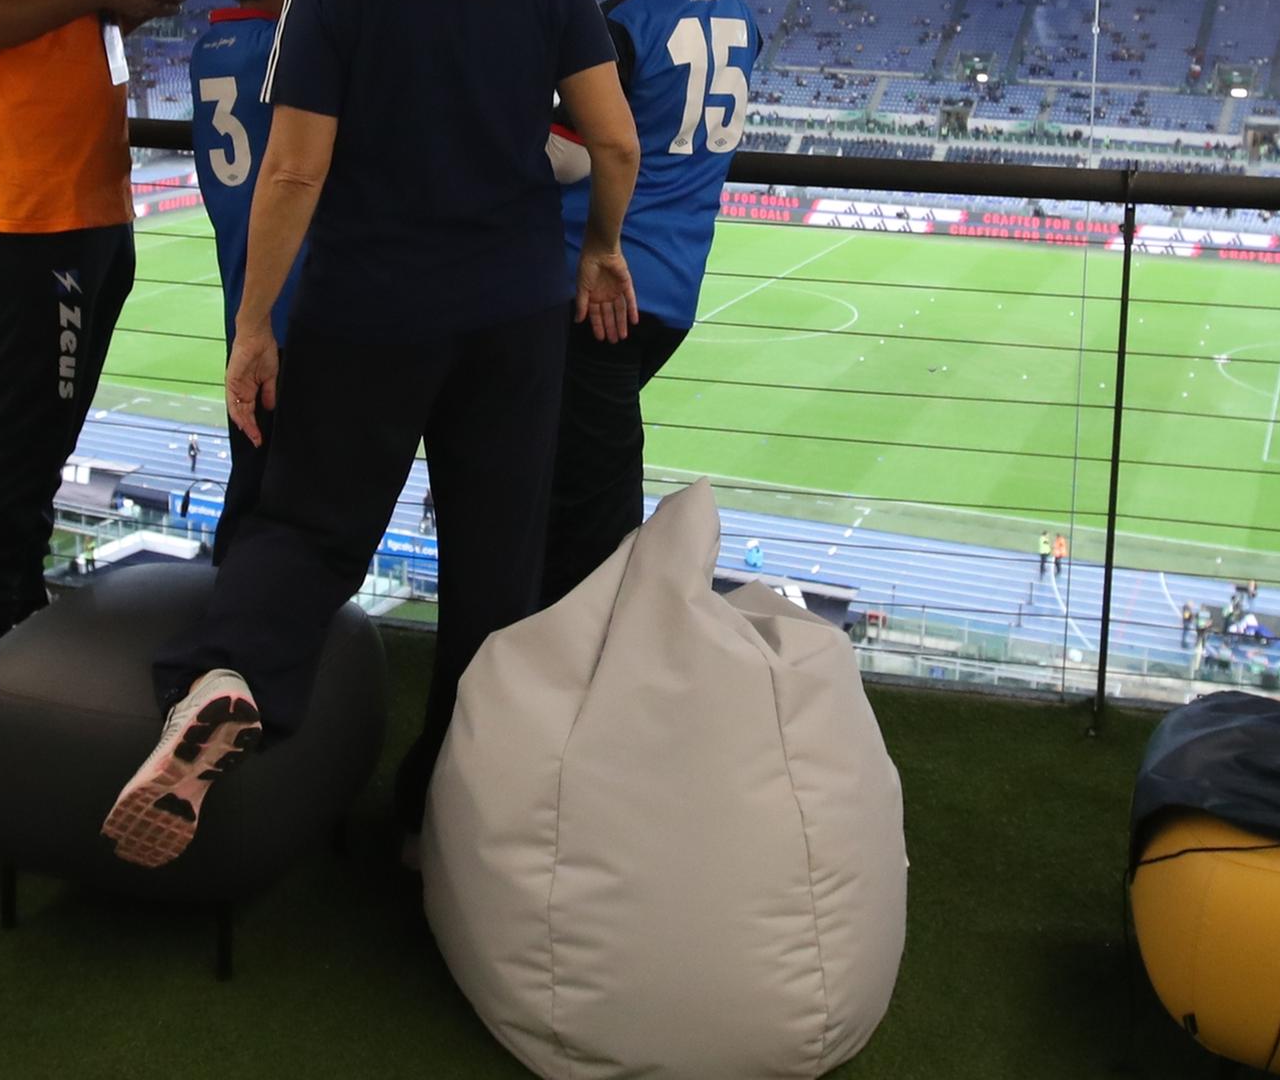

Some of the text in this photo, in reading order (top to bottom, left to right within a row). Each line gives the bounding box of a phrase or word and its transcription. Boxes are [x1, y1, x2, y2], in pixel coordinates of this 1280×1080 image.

[666, 16, 749, 155] 15
[199, 76, 252, 187] 3
[734, 192, 756, 205] FOR
[761, 195, 799, 208] GOALS
[722, 205, 791, 221] FOR GOALS
[983, 212, 1040, 229] CRAFTED
[1045, 217, 1070, 231] FOR
[949, 223, 1009, 238] CRAFTED
[1014, 230, 1041, 242] FOR
[58, 301, 81, 399] Zeus
